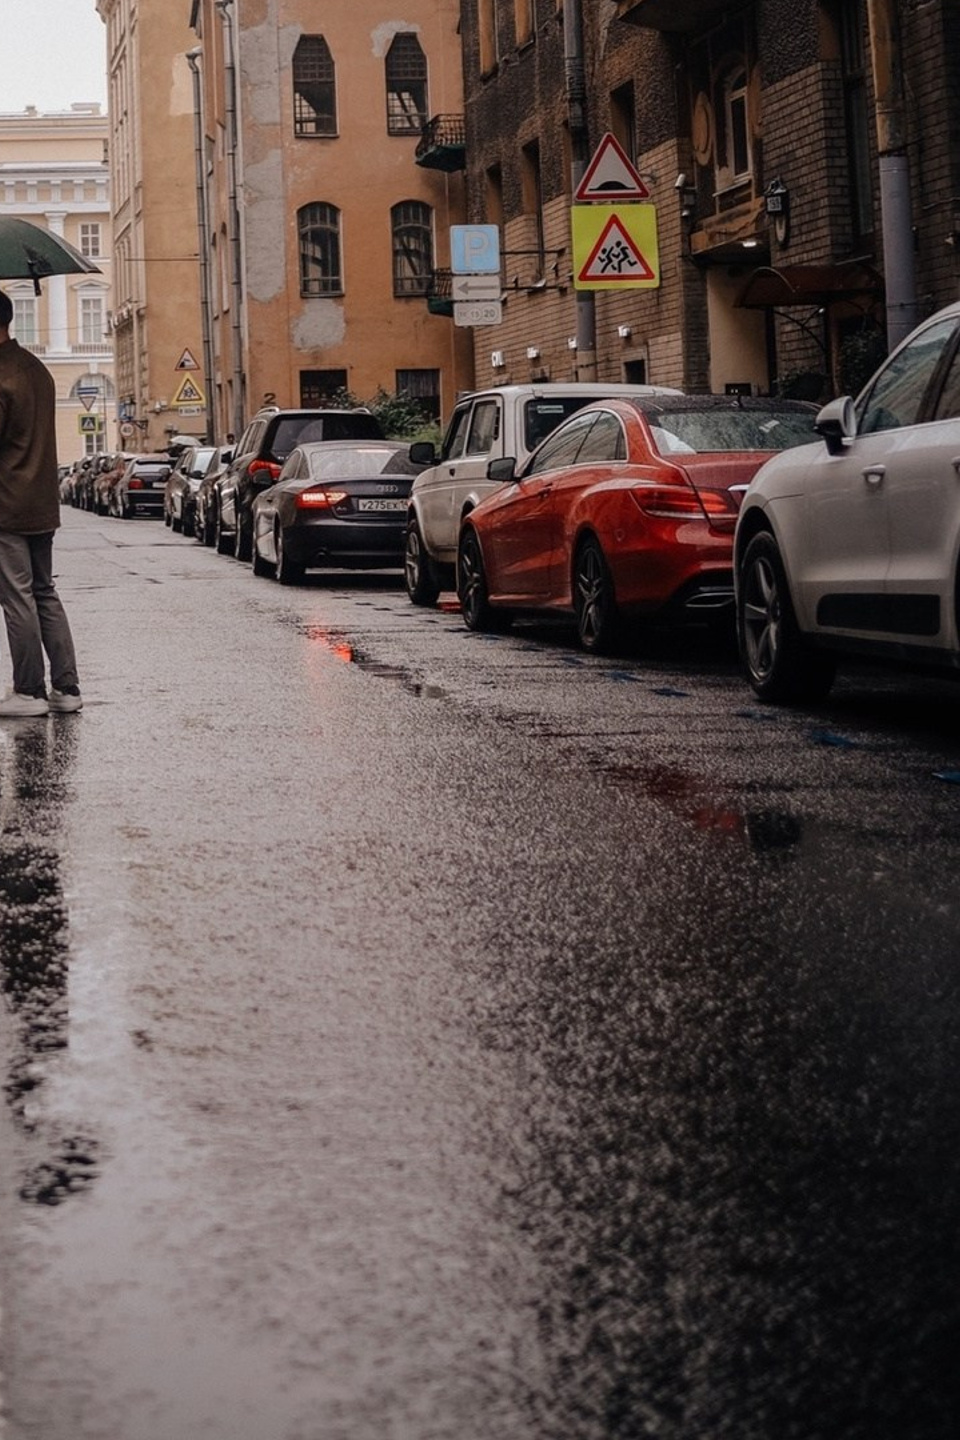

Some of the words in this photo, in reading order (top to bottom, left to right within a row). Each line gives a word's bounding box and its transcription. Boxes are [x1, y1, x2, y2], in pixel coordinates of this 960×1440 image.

[464, 231, 489, 268] P
[483, 309, 496, 318] 20
[264, 392, 276, 405] 2
